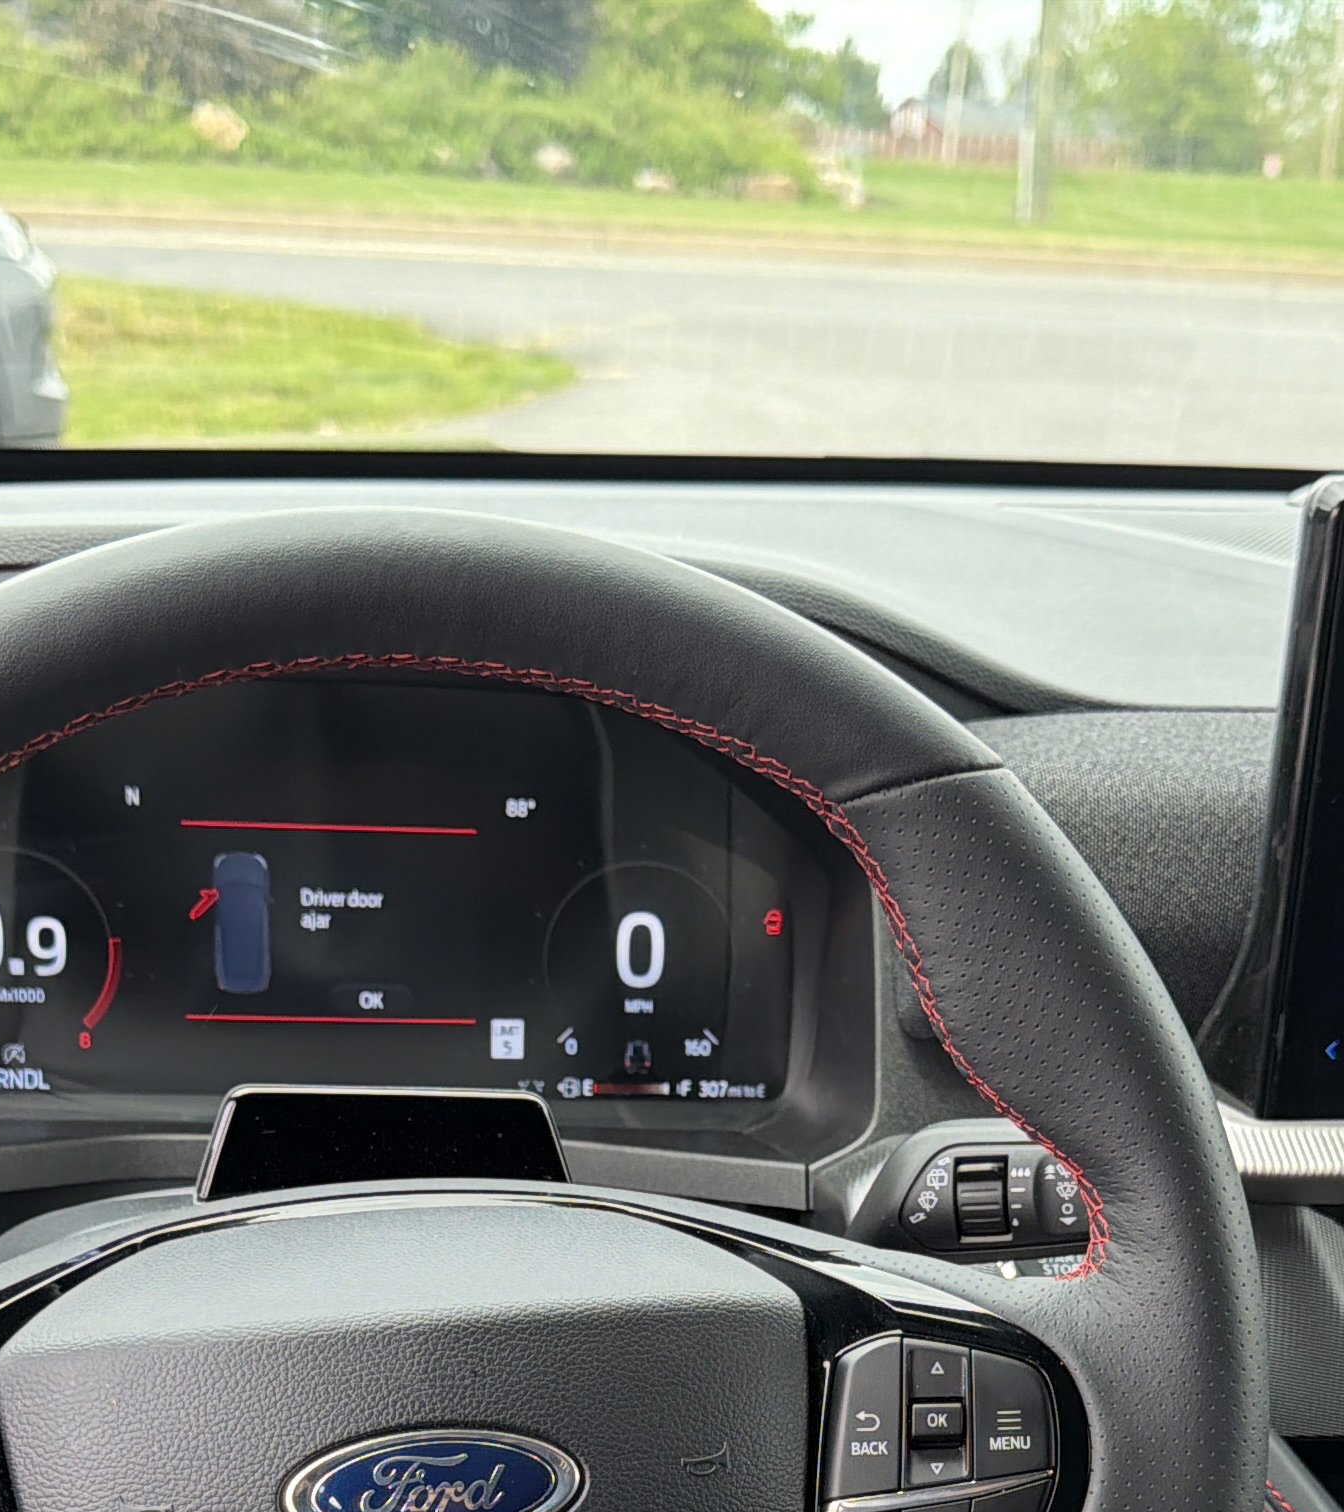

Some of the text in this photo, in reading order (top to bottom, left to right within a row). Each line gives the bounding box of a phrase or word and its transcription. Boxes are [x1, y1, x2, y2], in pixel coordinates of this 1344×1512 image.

[124, 786, 140, 807] N
[299, 886, 384, 909] Driver door
[299, 910, 332, 932] ajar
[615, 911, 666, 989] 0
[358, 990, 384, 1010] OK
[624, 999, 654, 1014] MPH
[582, 1078, 594, 1097] E
[926, 1412, 948, 1429] OK
[850, 1441, 889, 1457] BACK
[988, 1435, 1031, 1452] MENU
